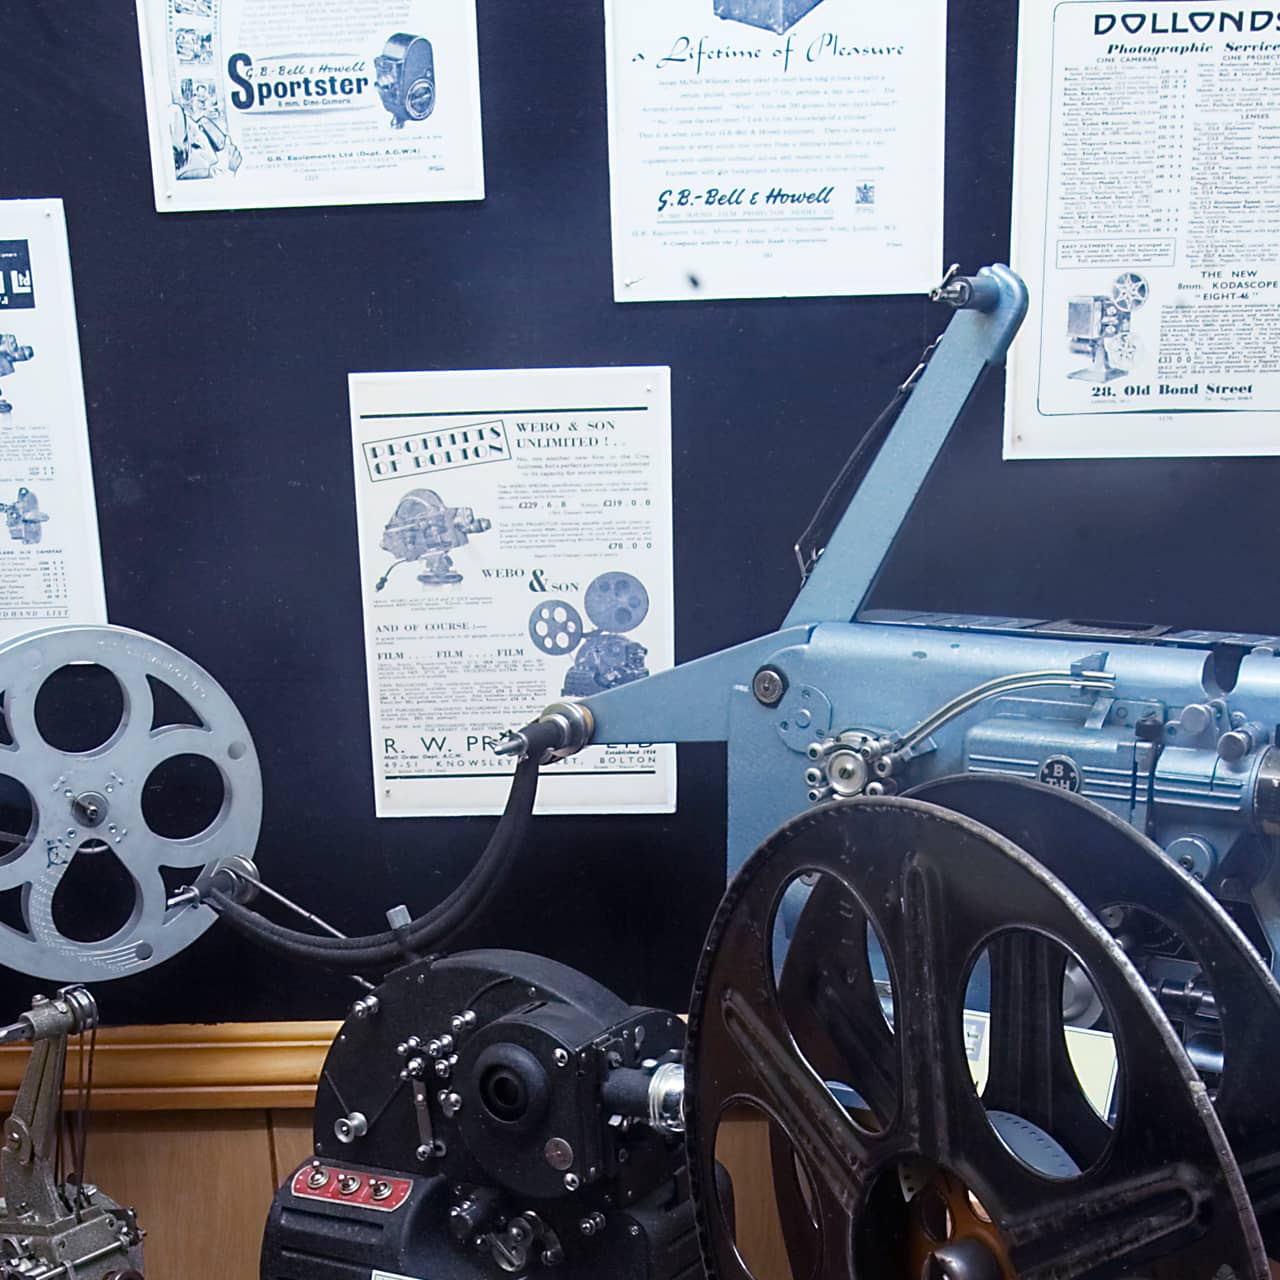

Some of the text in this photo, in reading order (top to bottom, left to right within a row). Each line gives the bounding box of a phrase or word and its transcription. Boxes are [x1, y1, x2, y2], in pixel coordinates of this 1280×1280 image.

[632, 33, 904, 75] a Lifetime of Pleasure
[1107, 41, 1280, 56] Photographic Service
[228, 53, 368, 110] Sportster
[765, 186, 834, 205] Howell
[1231, 270, 1258, 278] NEW
[1212, 281, 1278, 289] KODASCOPE
[1124, 384, 1253, 396] Old Bond Street
[516, 421, 615, 432] WEBO & SON
[516, 437, 598, 449] UNLIMITED
